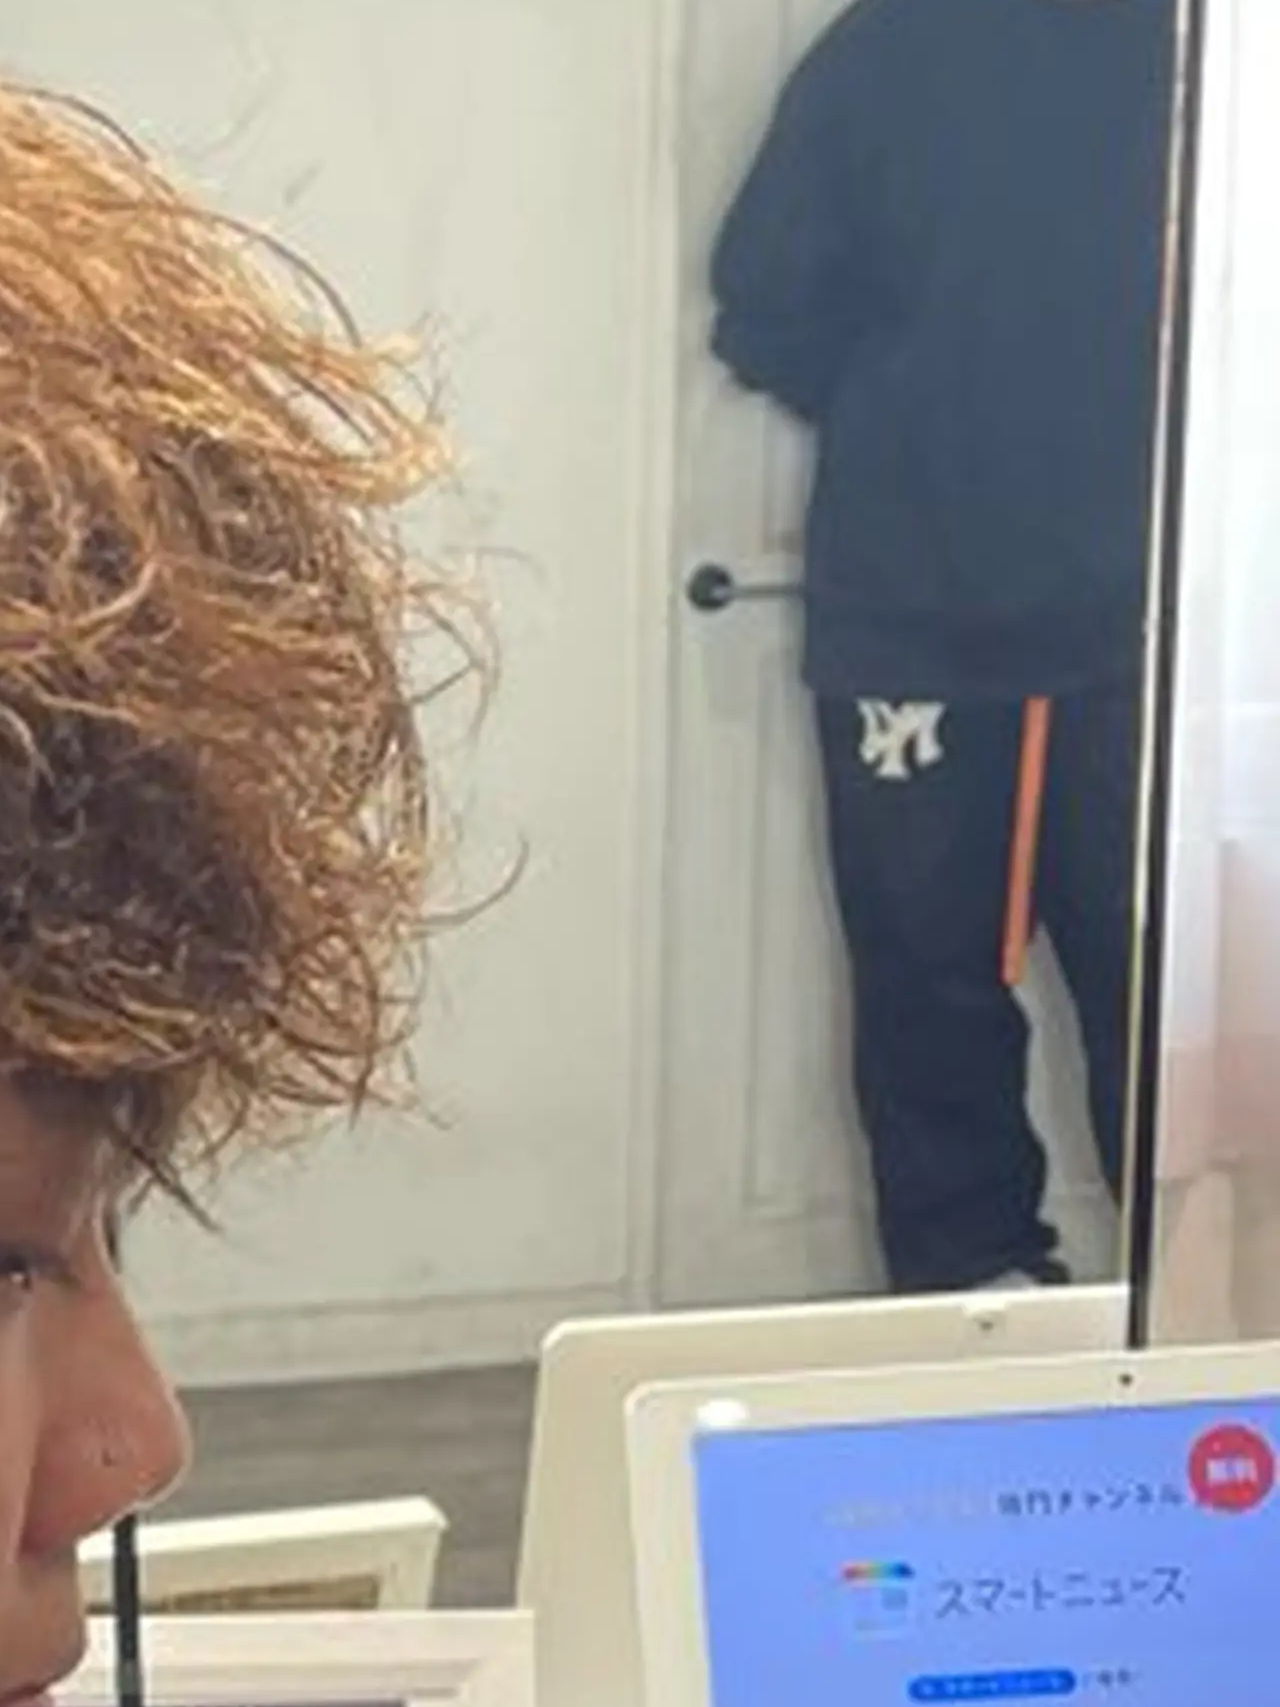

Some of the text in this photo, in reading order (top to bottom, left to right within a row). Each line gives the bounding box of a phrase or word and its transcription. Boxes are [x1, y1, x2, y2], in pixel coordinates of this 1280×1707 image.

[936, 1567, 1187, 1618] スマートニュース
